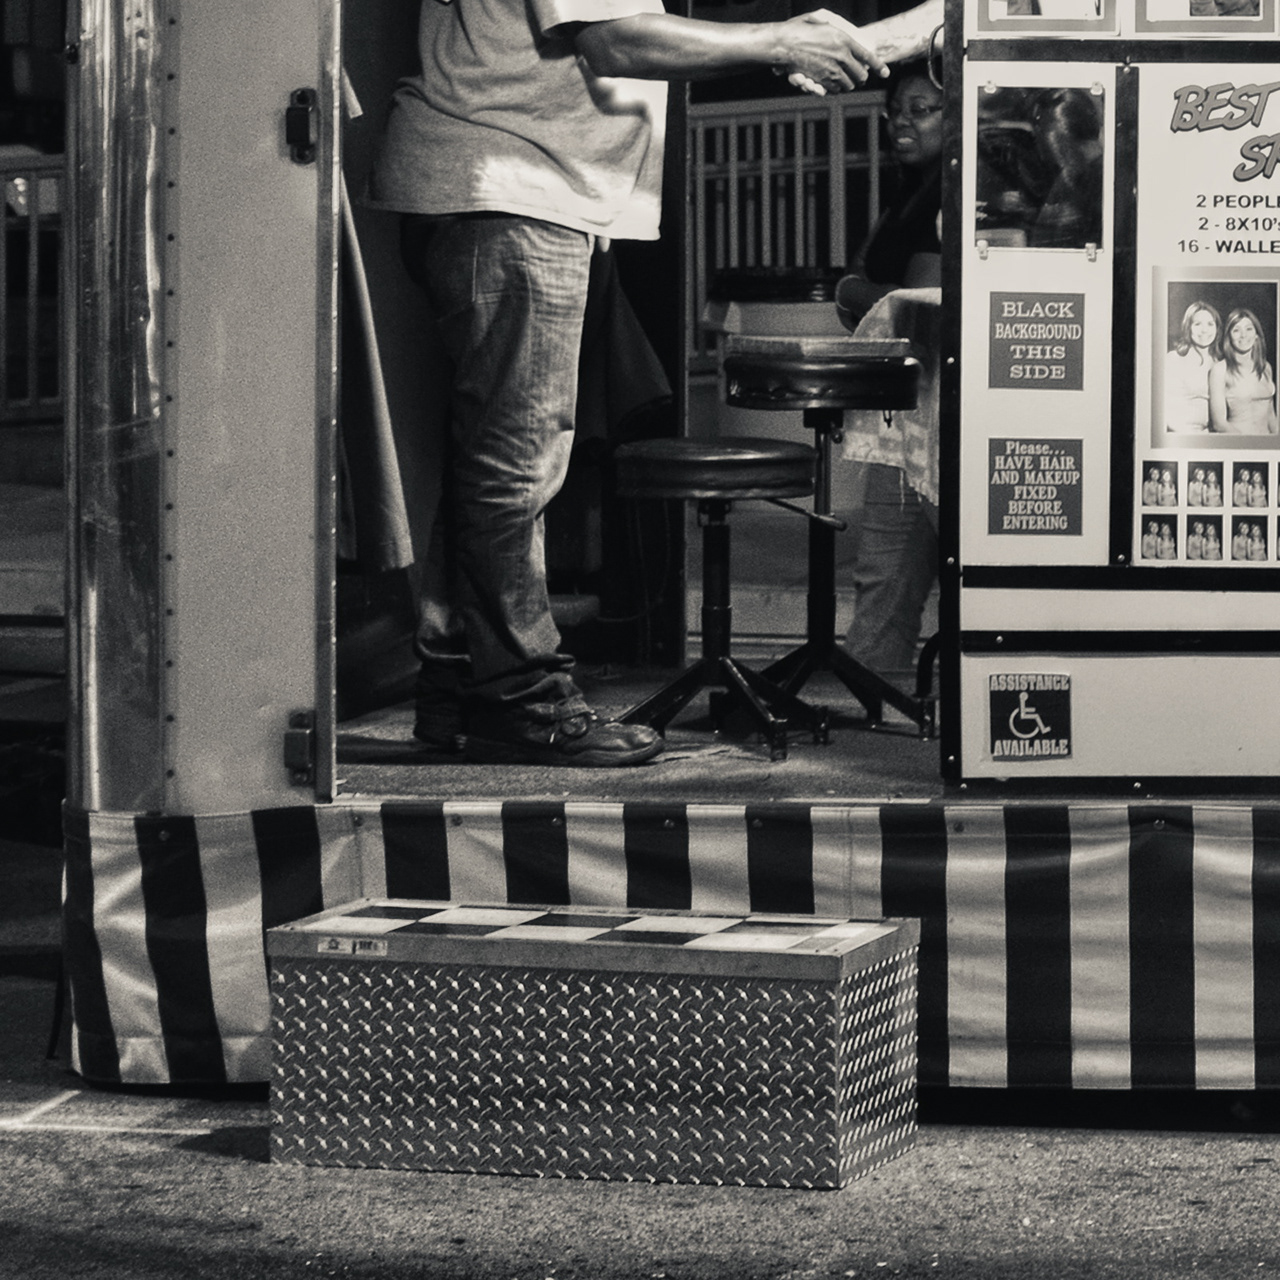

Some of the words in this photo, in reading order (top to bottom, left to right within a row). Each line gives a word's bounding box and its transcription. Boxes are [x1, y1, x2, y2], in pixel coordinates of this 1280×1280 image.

[1195, 194, 1207, 208] 2
[1198, 217, 1209, 231] 2
[1177, 240, 1199, 253] 16
[1001, 301, 1075, 318] BLACK
[994, 323, 1082, 340] BACKGROUND
[1009, 345, 1066, 359] THIS
[1009, 365, 1066, 380] SIDE
[994, 456, 1033, 470] HAVE
[1039, 456, 1076, 470] HAIR
[991, 471, 1020, 485] AND
[1024, 471, 1081, 485] MAKEUP
[1013, 486, 1057, 500] FIXED
[1008, 500, 1063, 515] BEFORE
[1002, 516, 1068, 530] ENTERING
[990, 674, 1070, 691] ASSISTANCE
[993, 739, 1068, 756] AVAILABLE
